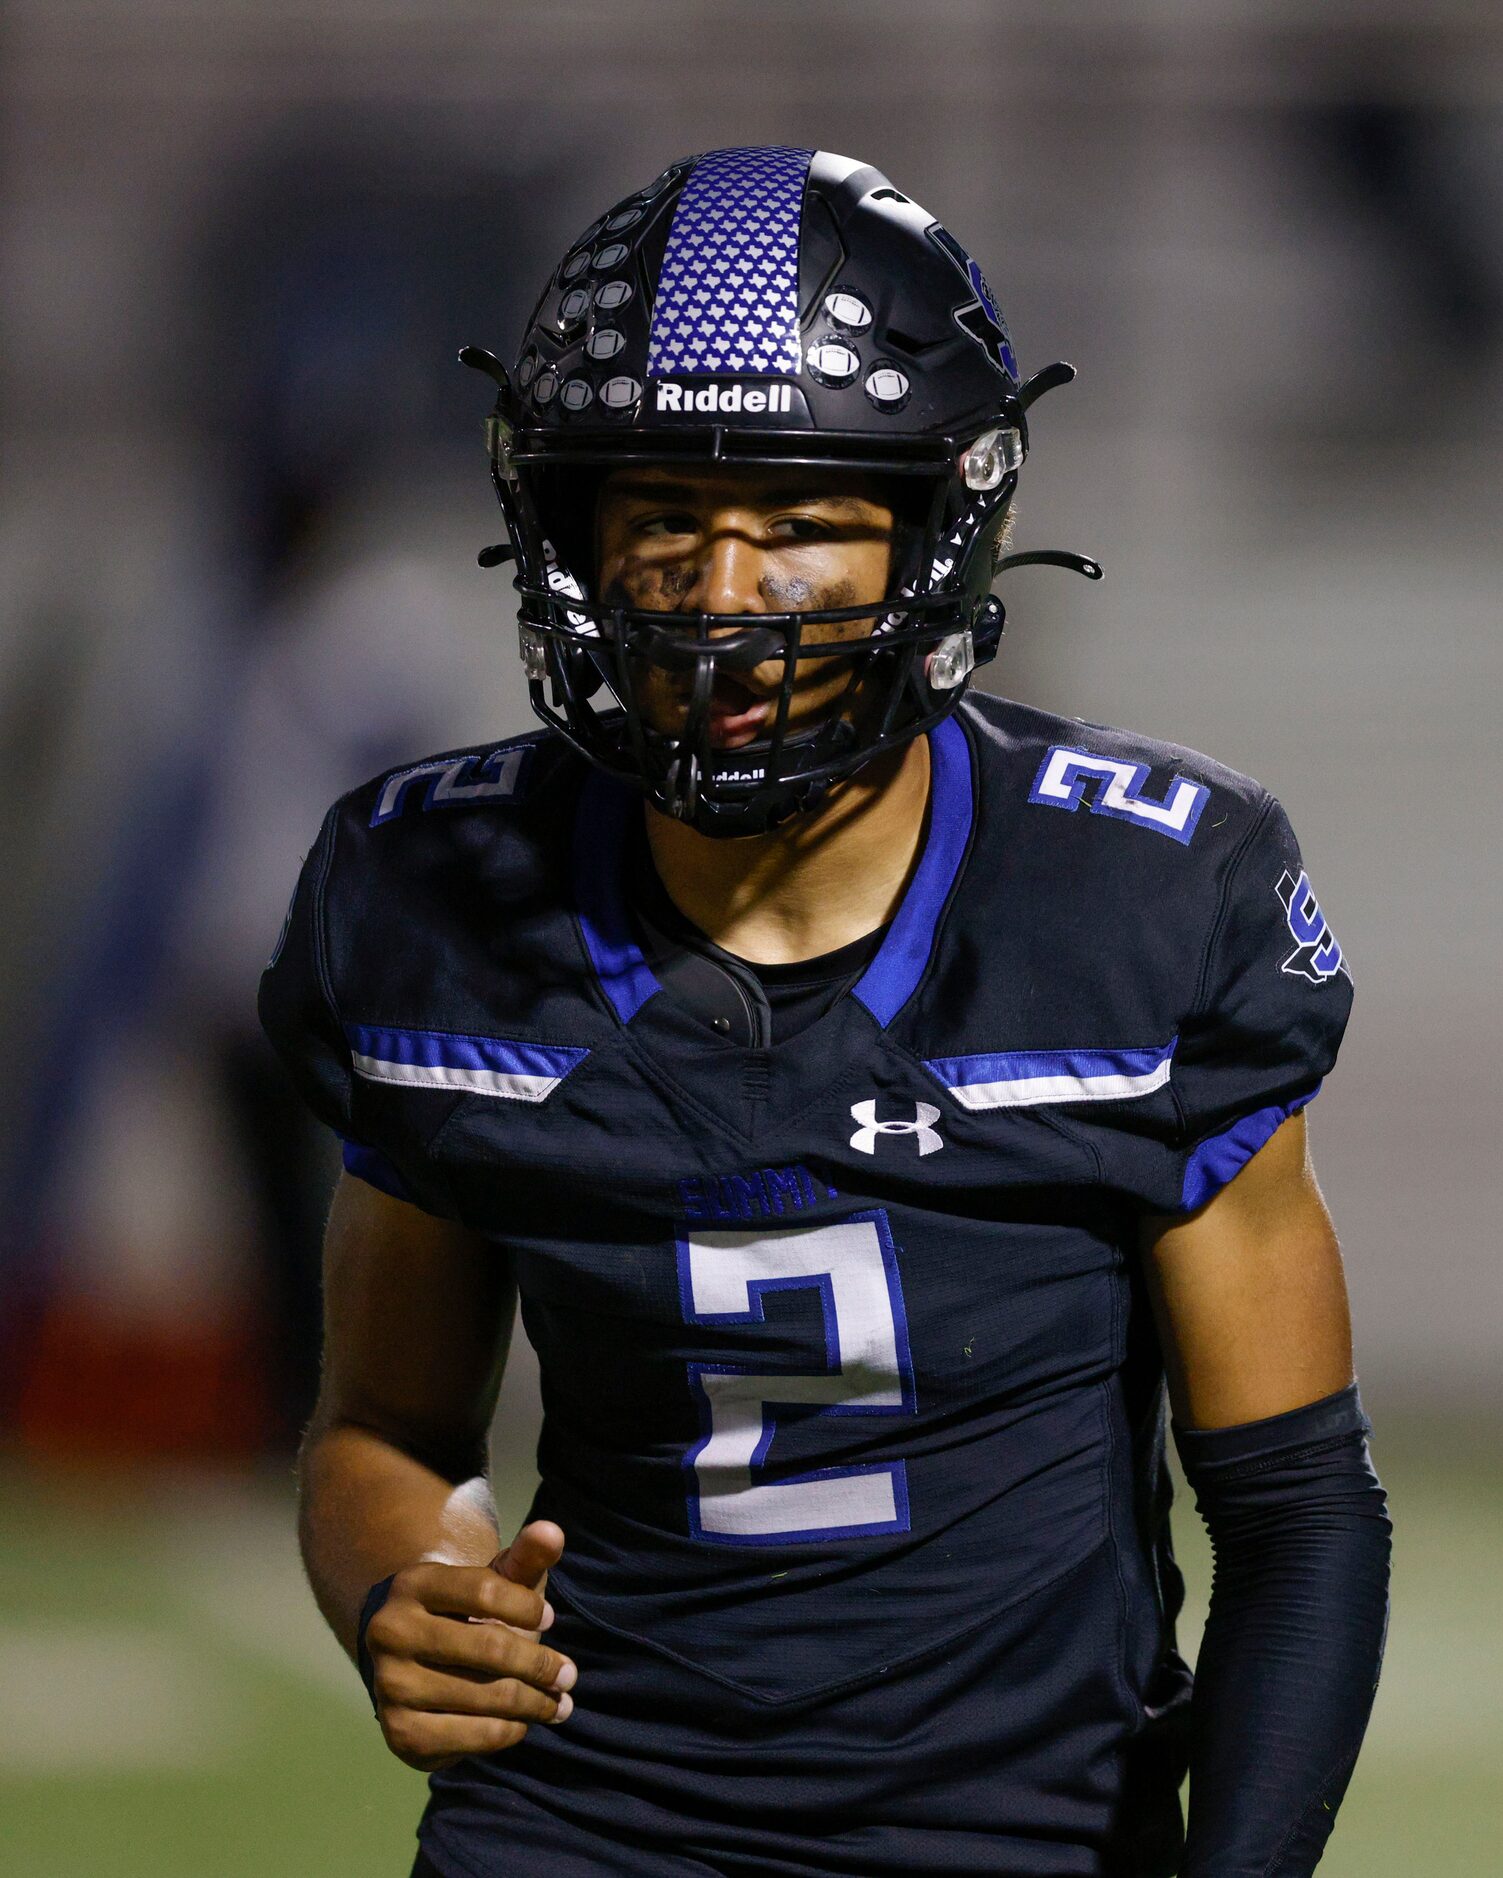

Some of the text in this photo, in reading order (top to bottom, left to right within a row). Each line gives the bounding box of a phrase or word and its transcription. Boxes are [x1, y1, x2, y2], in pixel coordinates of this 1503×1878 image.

[656, 380, 792, 413] Riddell
[368, 744, 537, 829] 2
[1027, 745, 1212, 847] 2
[676, 1165, 840, 1218] SUMMI
[675, 1207, 917, 1546] 2
